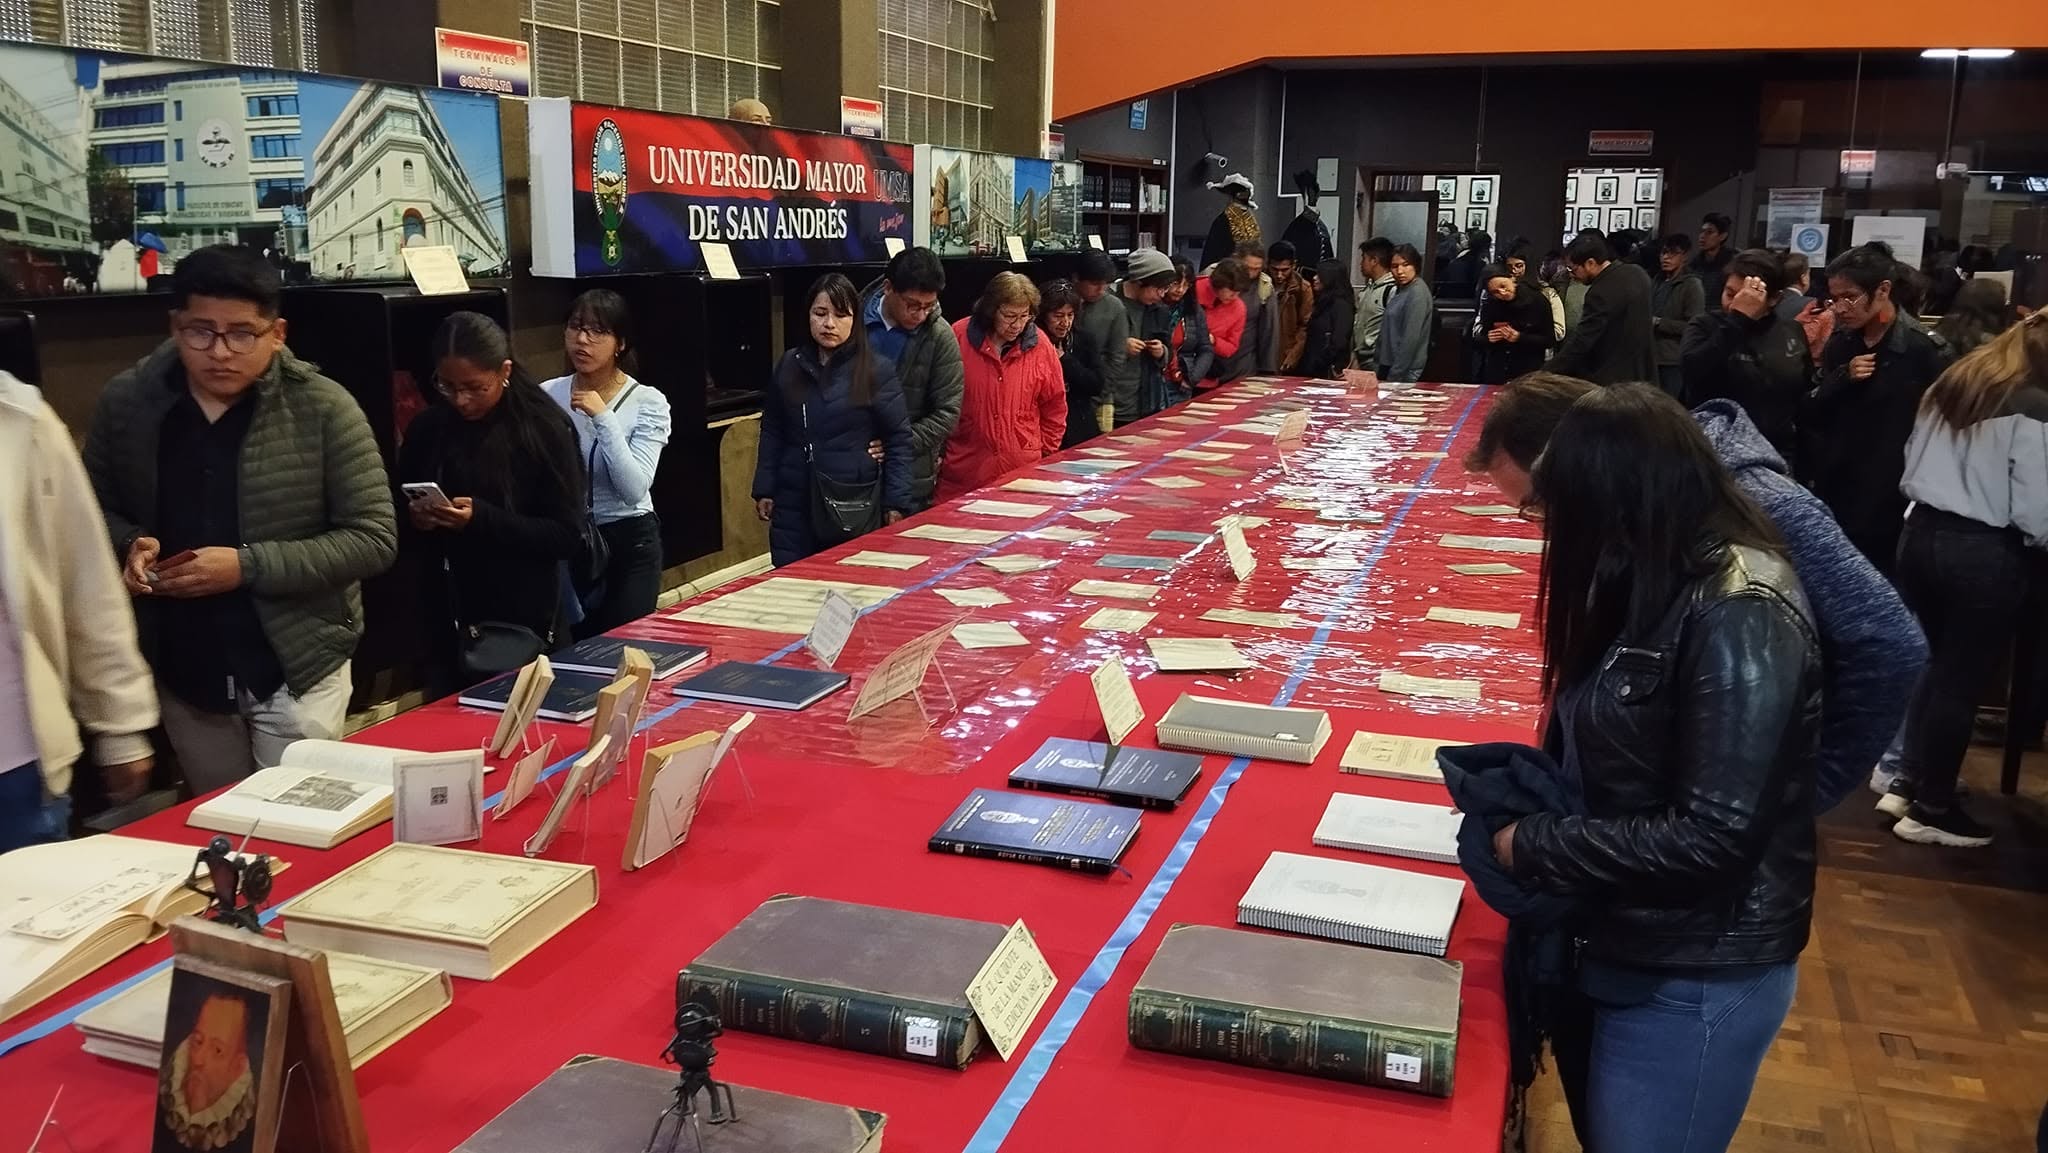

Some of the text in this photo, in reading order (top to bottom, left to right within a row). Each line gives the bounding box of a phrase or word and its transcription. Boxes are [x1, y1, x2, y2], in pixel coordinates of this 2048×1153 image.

[453, 48, 517, 66] TERMINALES
[459, 75, 513, 93] CONSULTA
[479, 66, 493, 77] DE
[648, 145, 867, 194] UNIVERSIDAD MAYOR
[873, 169, 910, 203] UMSA
[688, 200, 848, 241] DE SAN ANDRÉS
